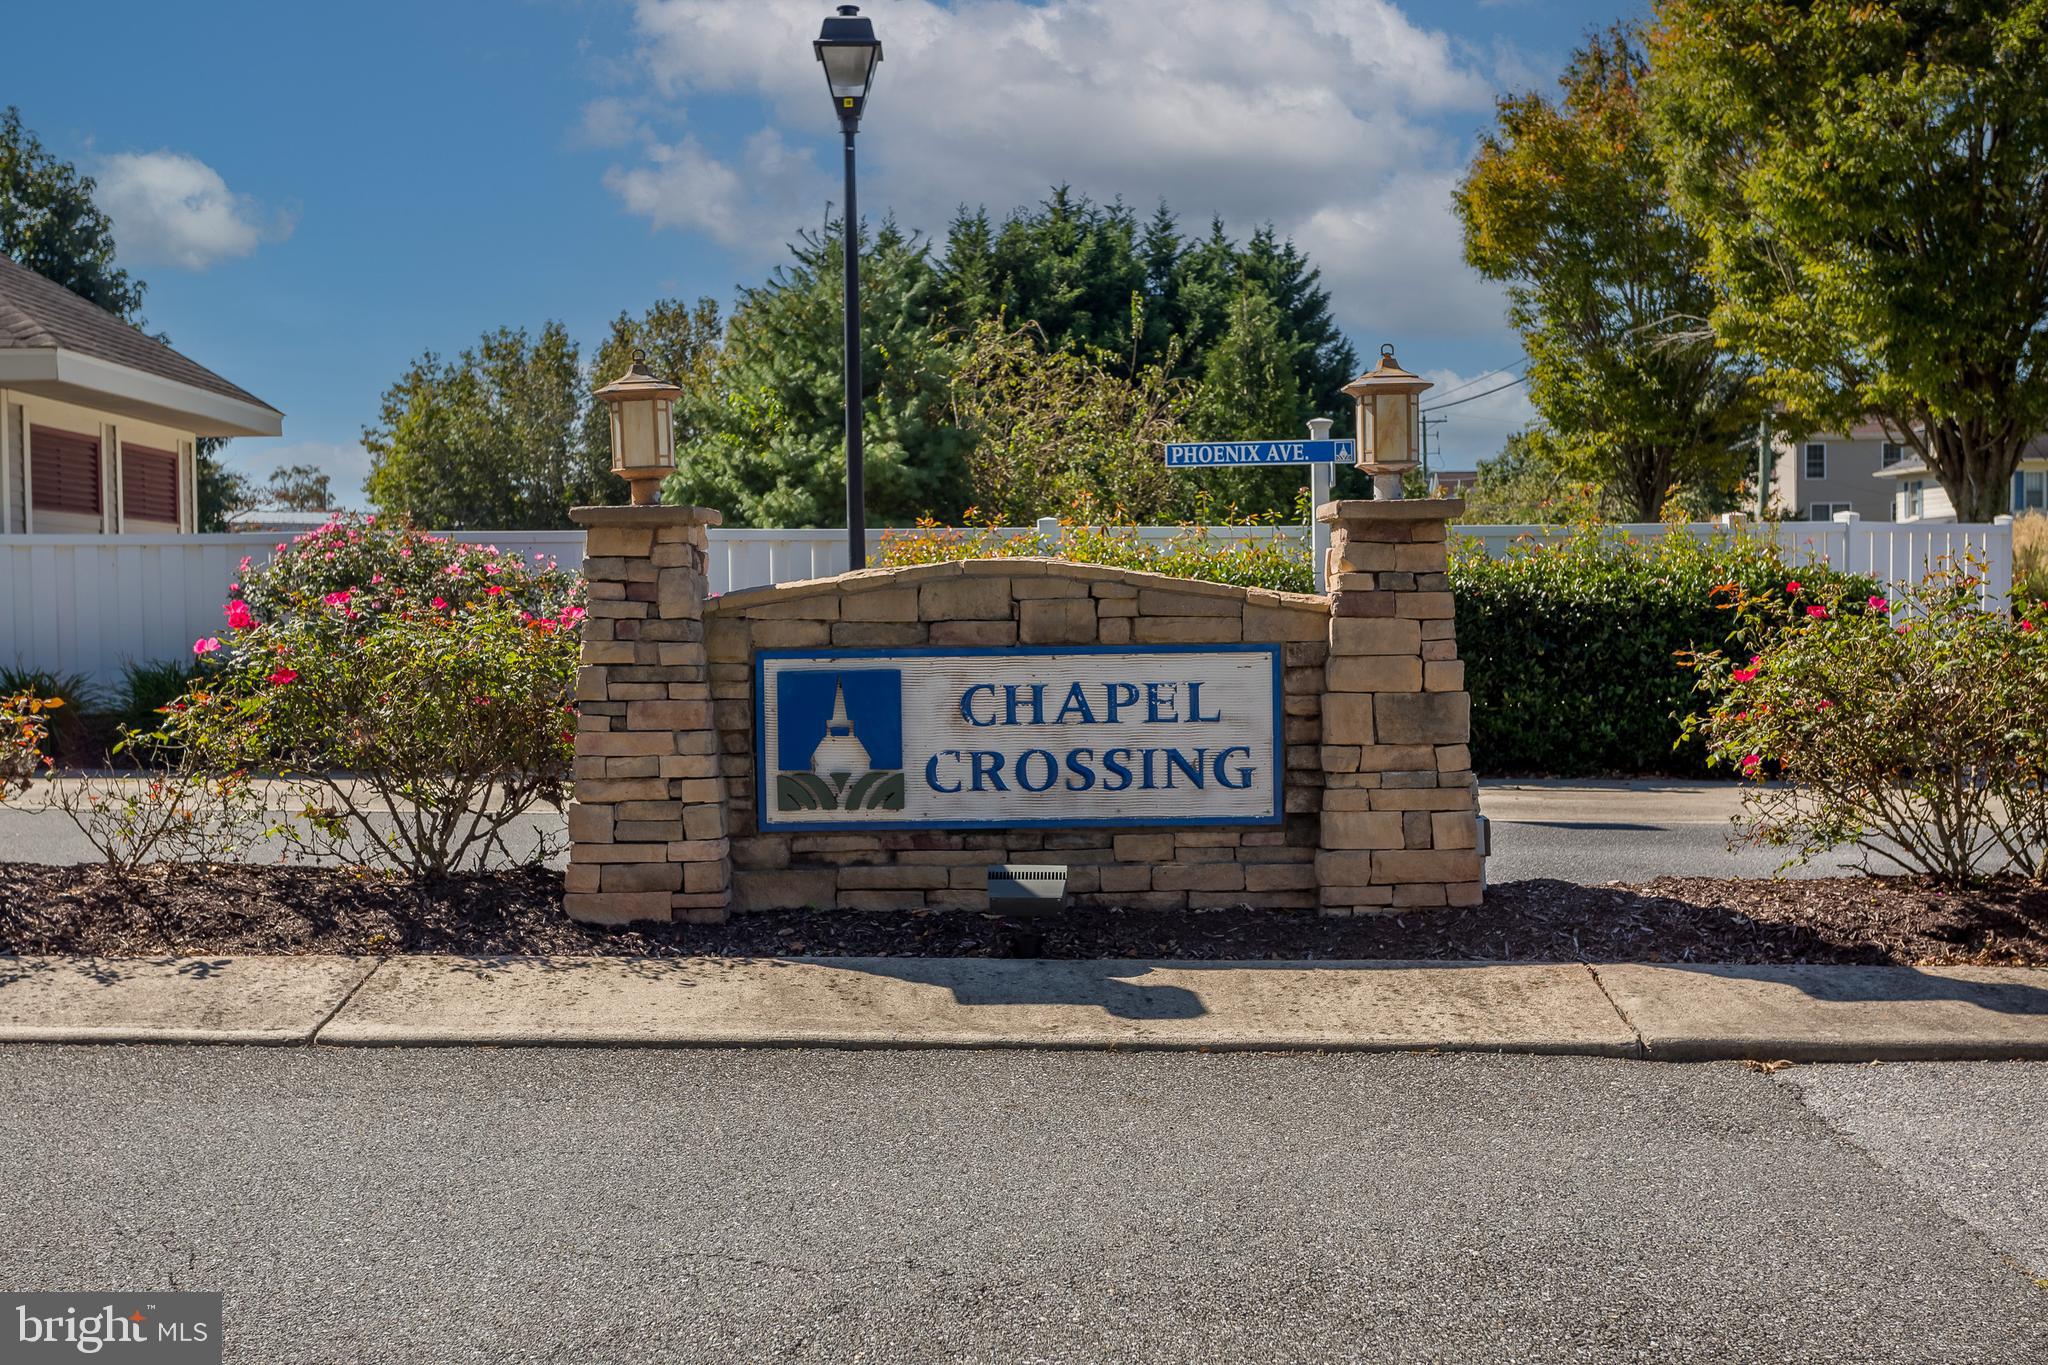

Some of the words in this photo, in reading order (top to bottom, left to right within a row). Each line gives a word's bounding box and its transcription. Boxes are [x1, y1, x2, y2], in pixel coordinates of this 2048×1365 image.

[1170, 444, 1260, 464] PHOENIX
[1265, 443, 1309, 462] AVE.
[959, 681, 1222, 727] CHAPEL
[924, 745, 1256, 794] CROSSING
